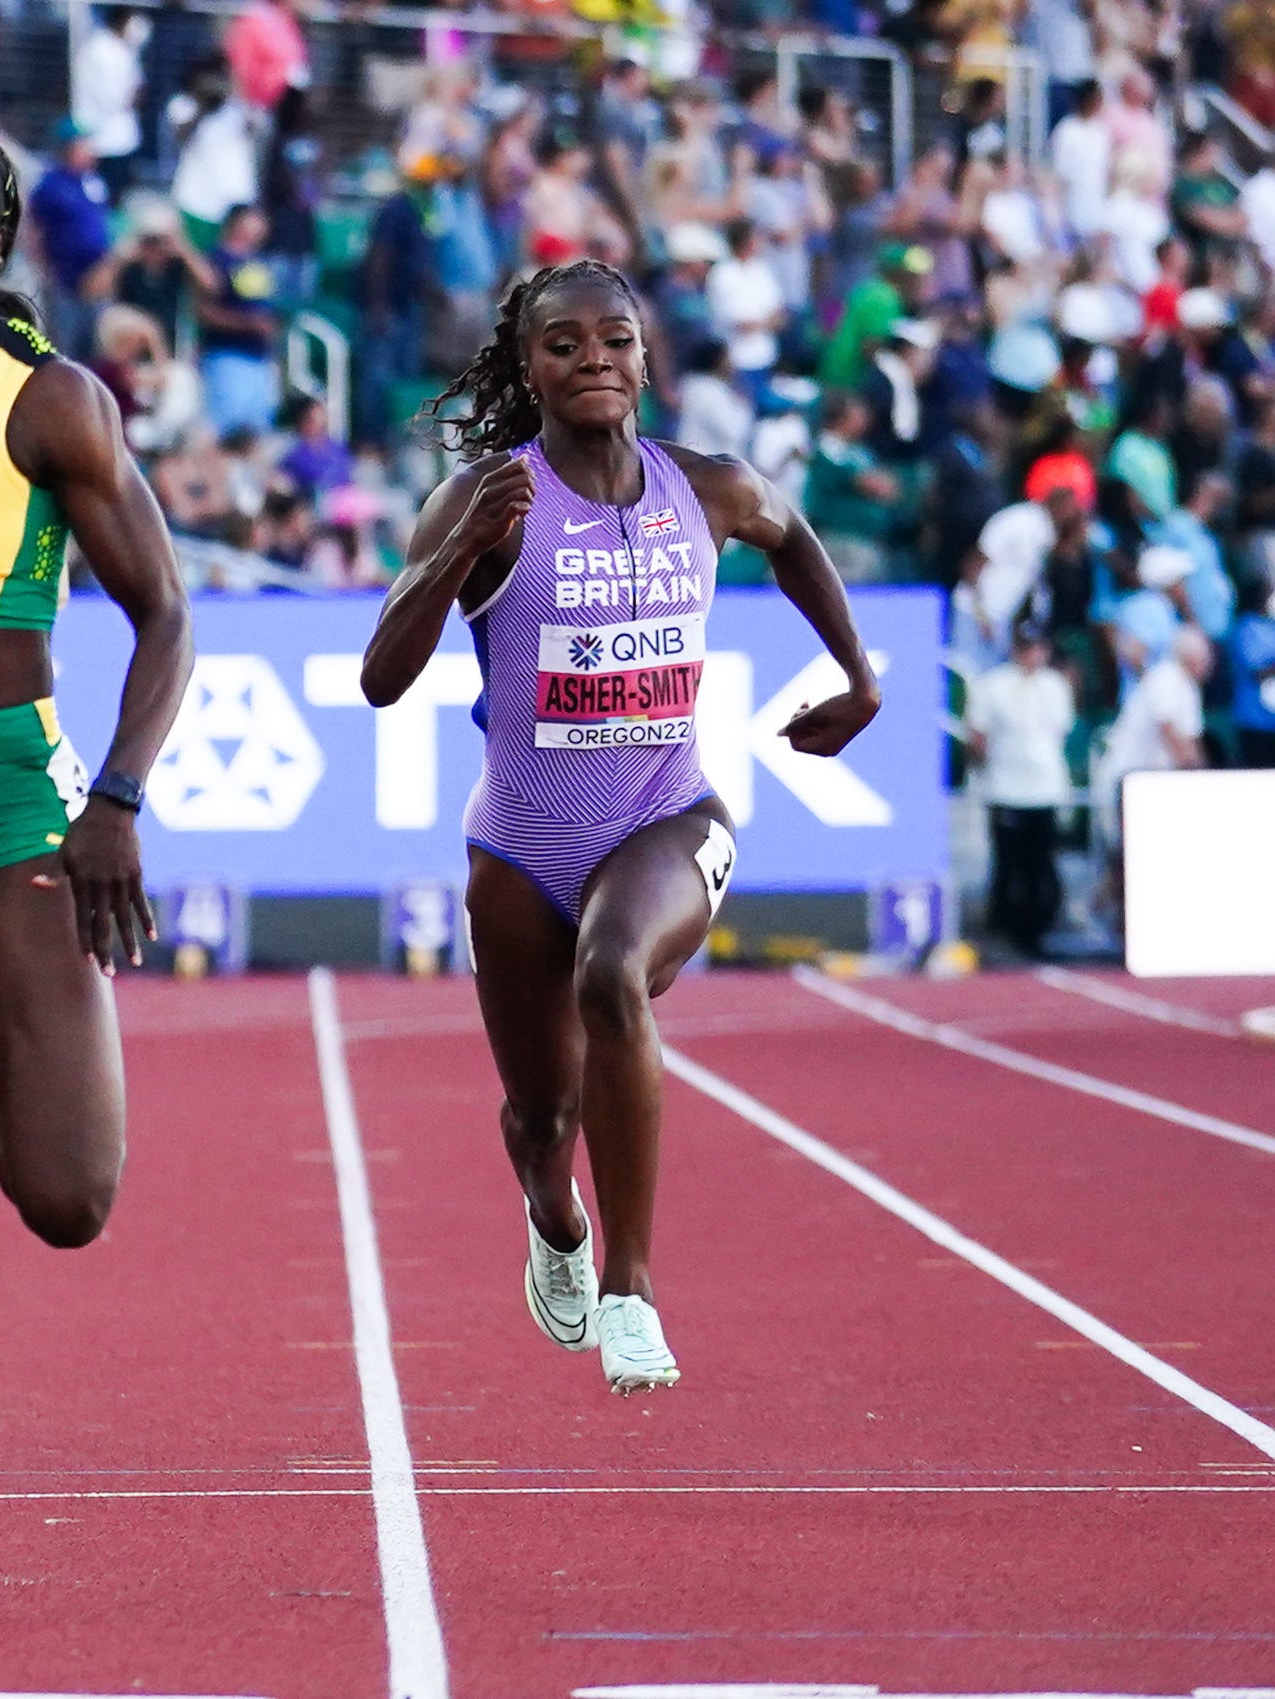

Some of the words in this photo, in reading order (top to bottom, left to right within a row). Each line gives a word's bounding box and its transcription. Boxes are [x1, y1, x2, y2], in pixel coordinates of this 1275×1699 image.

[555, 542, 692, 575] GREAT
[555, 576, 702, 608] BRITAIN
[612, 627, 685, 661] QNB
[545, 665, 702, 713] ASHER-SMITH
[303, 650, 895, 828] TK
[567, 721, 690, 745] OREGON22
